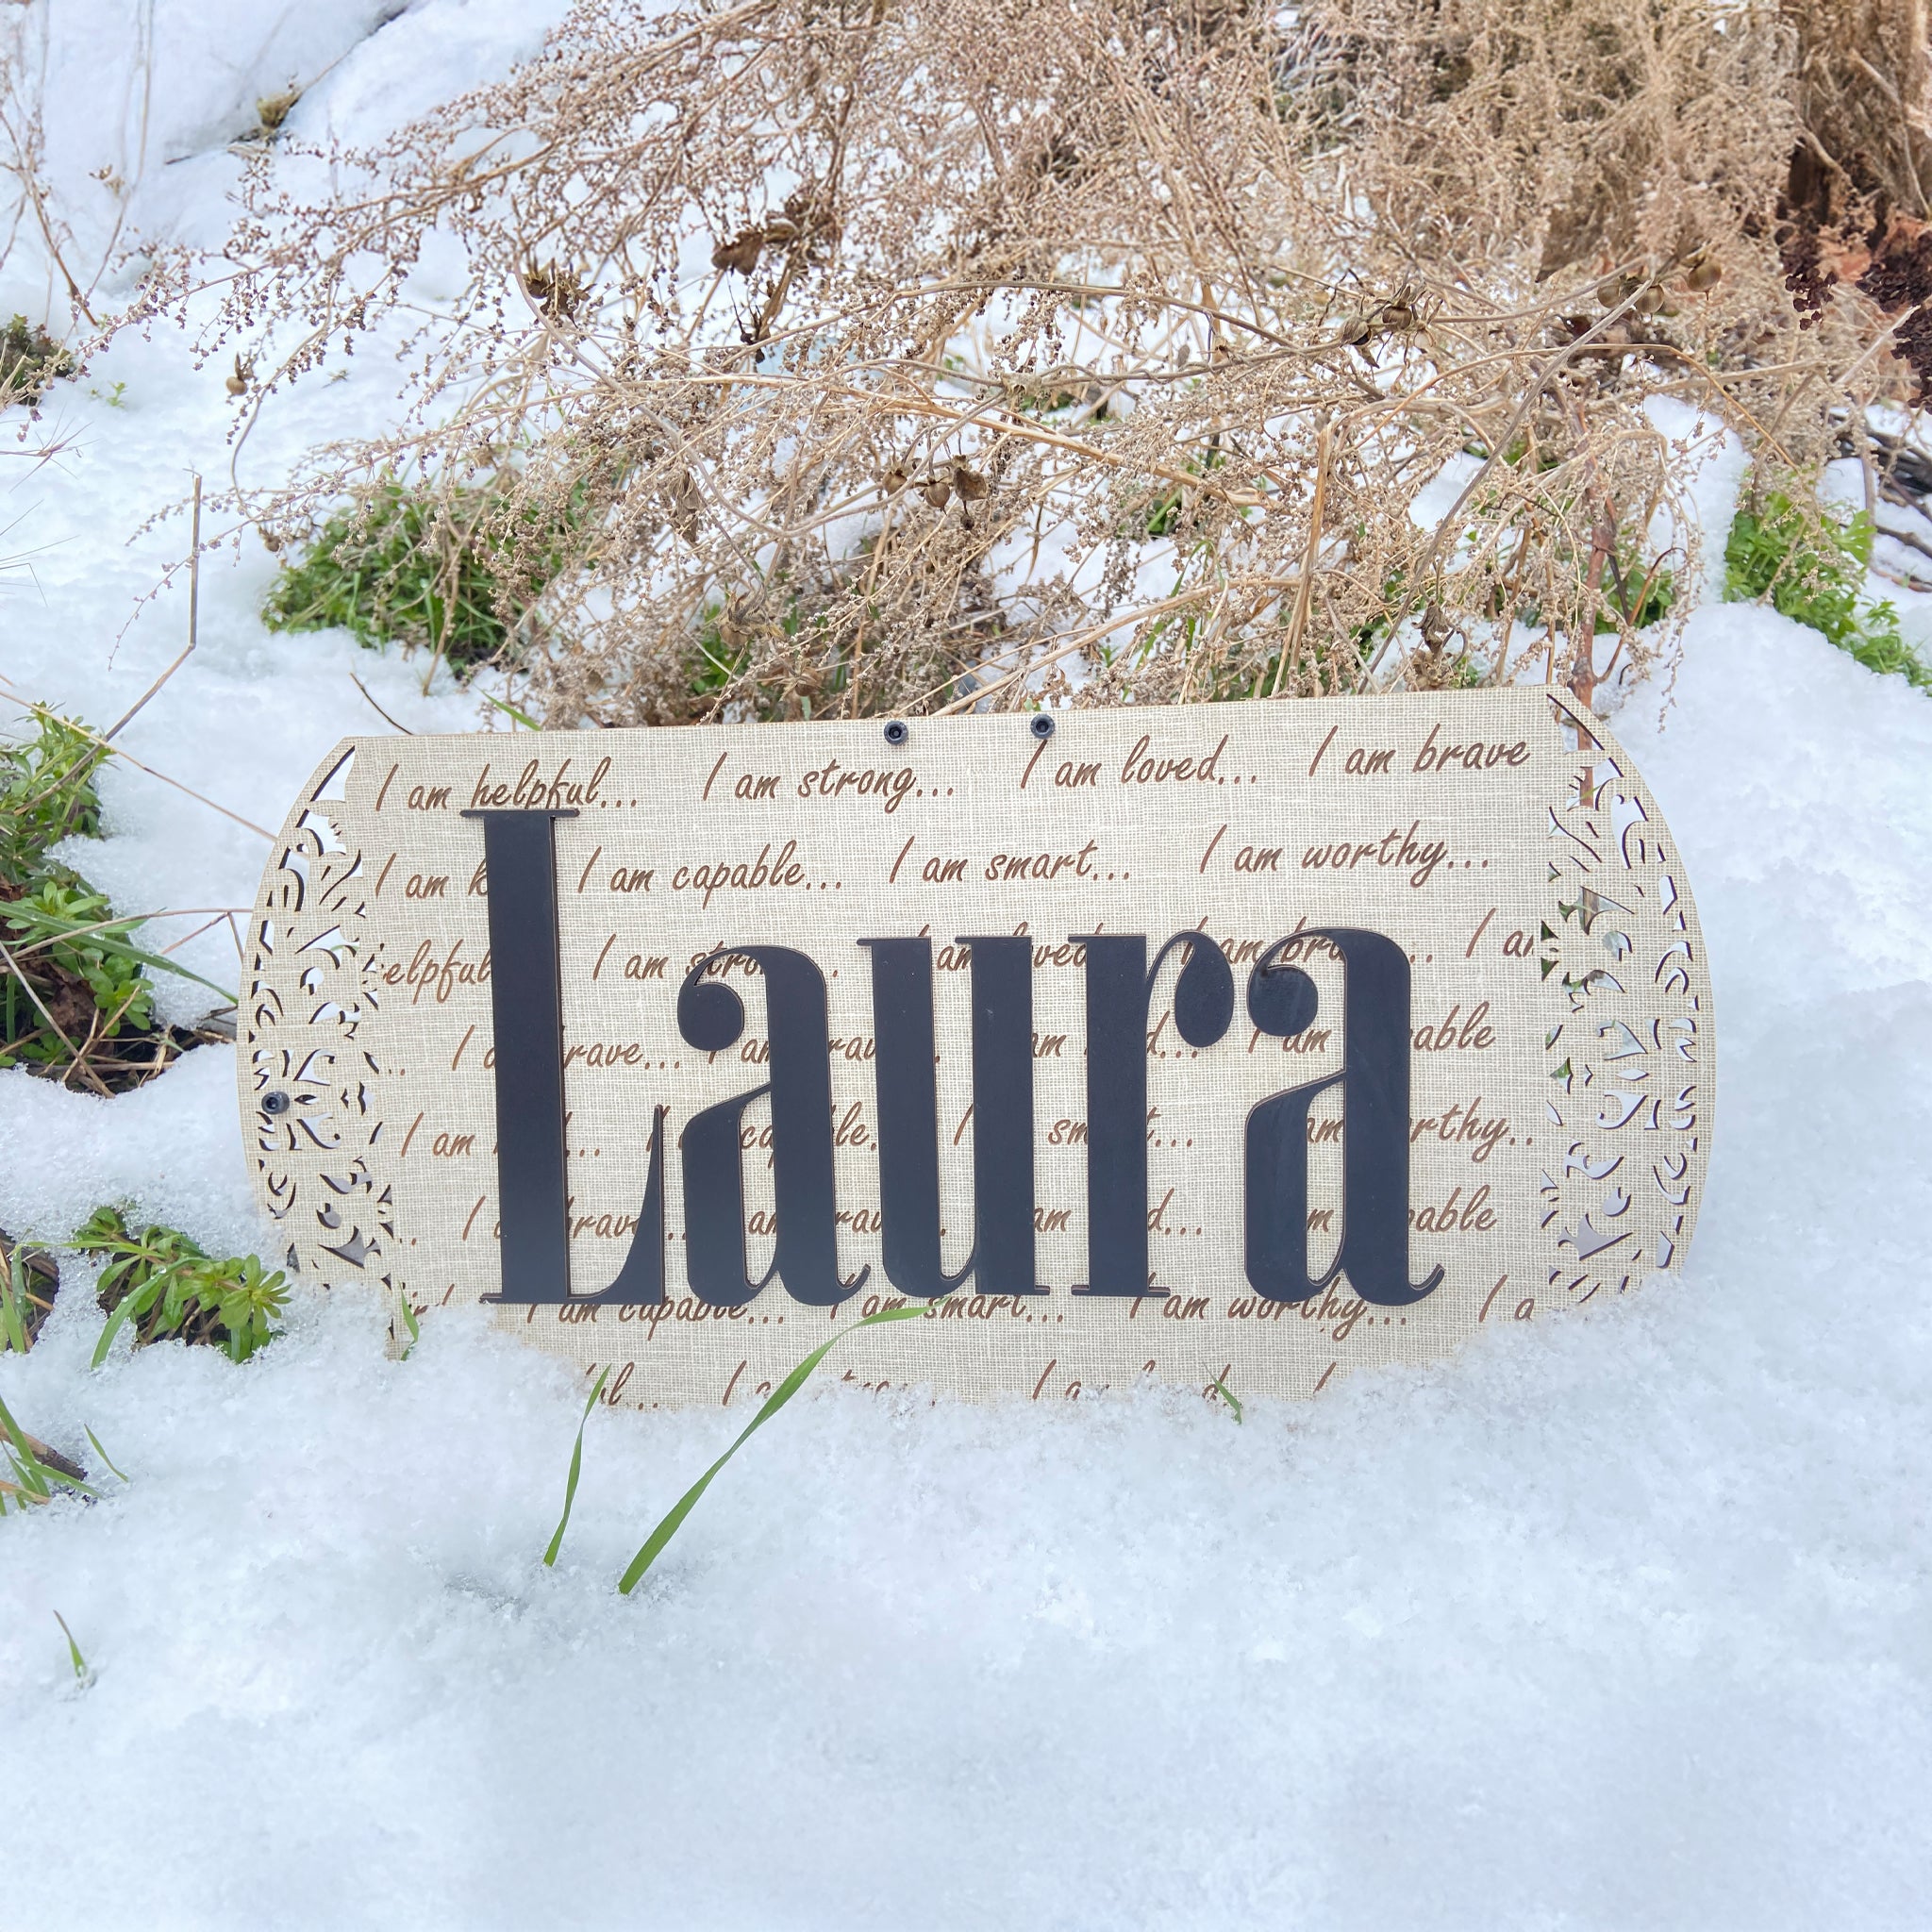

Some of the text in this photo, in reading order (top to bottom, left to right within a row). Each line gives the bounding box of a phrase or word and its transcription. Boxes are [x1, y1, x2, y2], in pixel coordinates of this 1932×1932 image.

[375, 763, 399, 812] I
[408, 785, 452, 810] am
[703, 752, 727, 801] I
[734, 774, 781, 800] am
[797, 758, 954, 814] strong...
[1020, 740, 1048, 789] I
[1055, 760, 1102, 787] am
[1121, 734, 1257, 785] loved...
[1308, 724, 1339, 776] I
[1345, 748, 1396, 774] am
[1413, 724, 1530, 773] brave
[375, 852, 397, 896] I
[406, 873, 449, 898] am
[577, 845, 602, 893] I
[609, 866, 655, 891] am
[672, 839, 842, 910] capable...
[890, 835, 915, 883] I
[922, 857, 968, 882] am
[985, 839, 1129, 881] smart...
[1200, 824, 1227, 874] I
[1234, 845, 1283, 872] am
[1302, 819, 1489, 888] worthy...
[382, 939, 491, 1005] elpful
[592, 933, 616, 980] I
[624, 954, 670, 979] am
[1465, 908, 1496, 958] I
[452, 1024, 475, 1071] I
[459, 808, 1445, 1308] Laura
[401, 1111, 425, 1157] I
[432, 1132, 475, 1157] am
[462, 1195, 486, 1241] I
[1163, 1294, 1210, 1319] am
[1478, 1274, 1507, 1323] I
